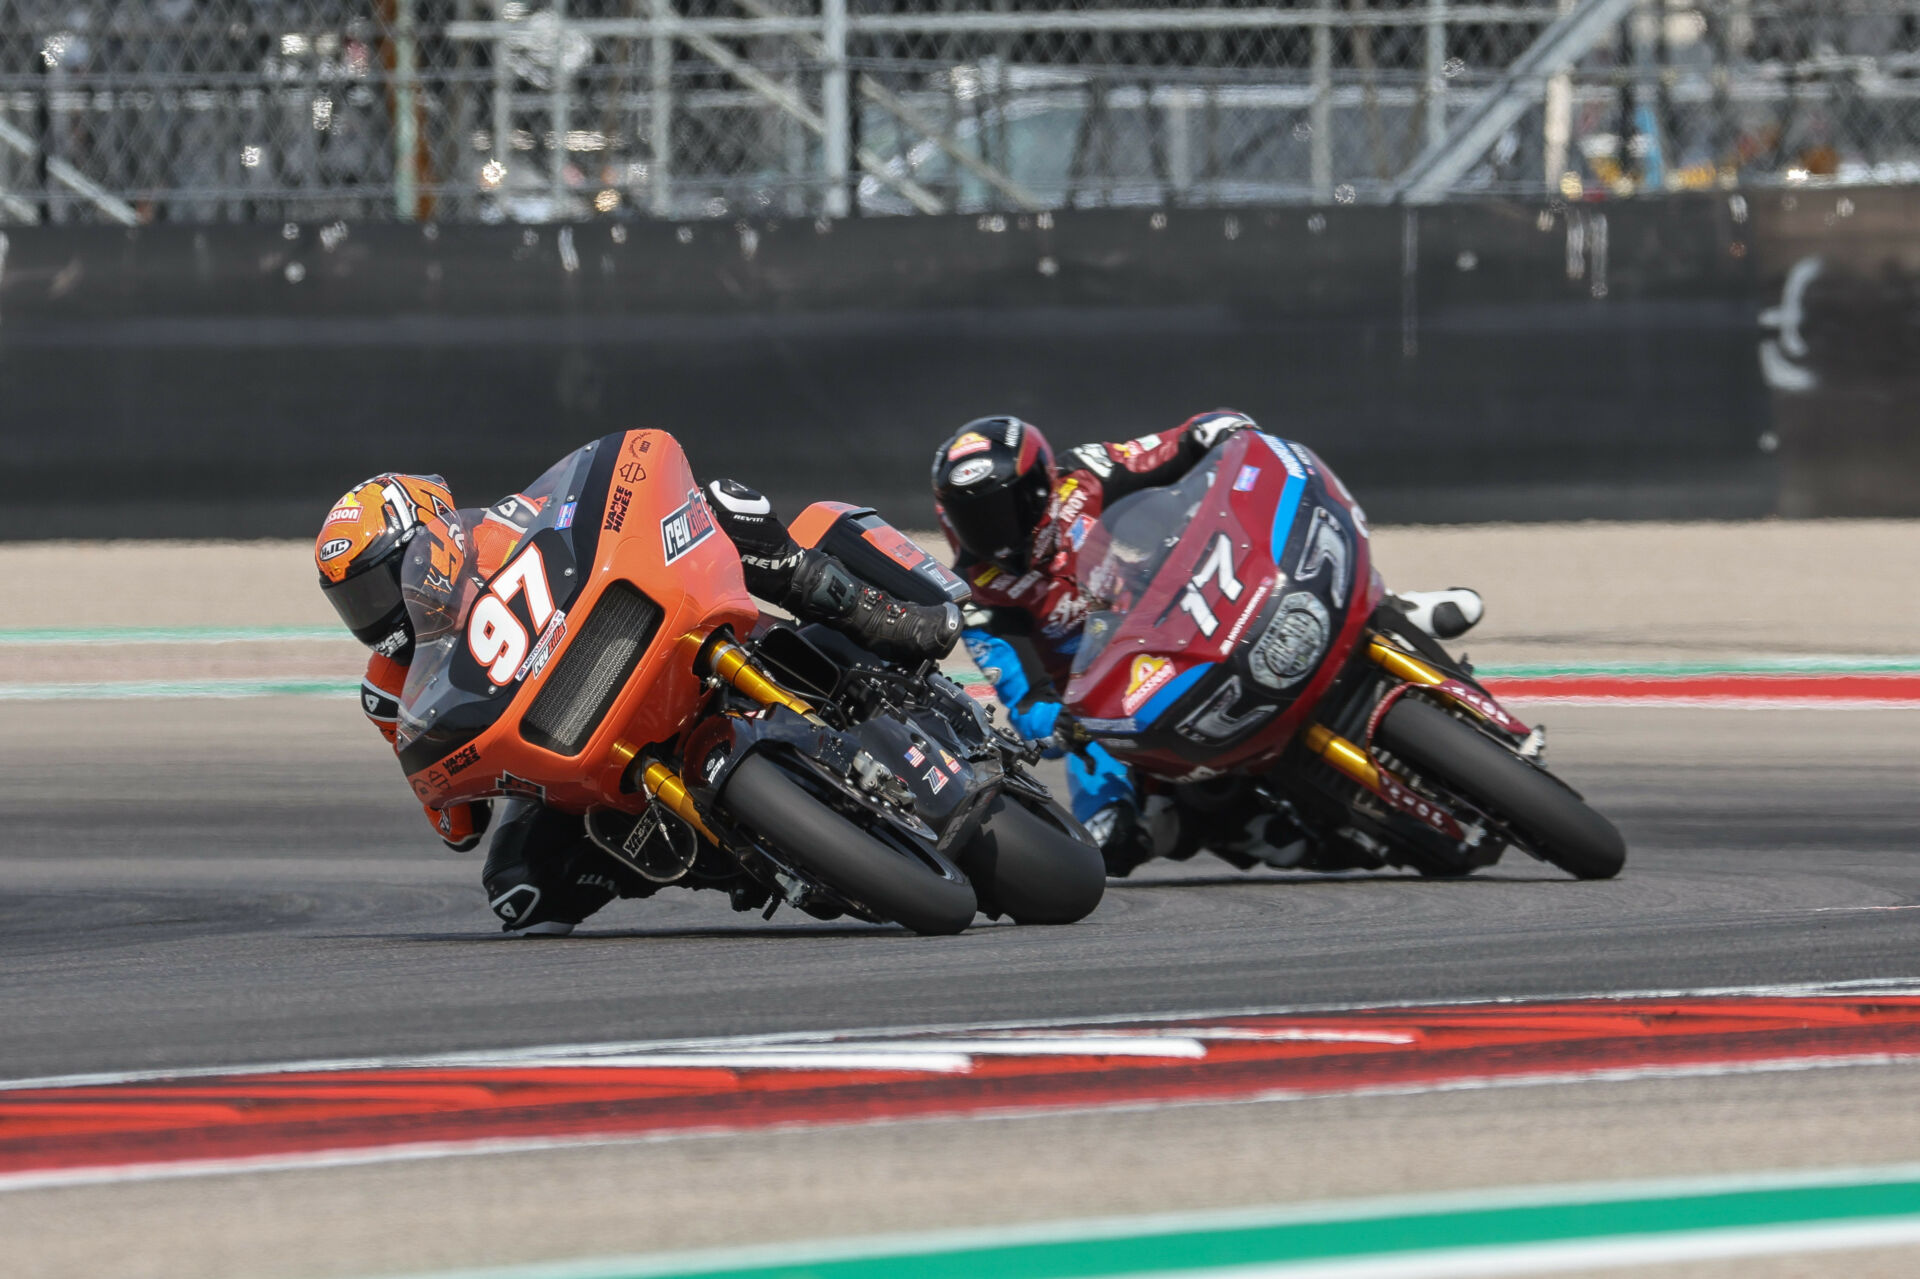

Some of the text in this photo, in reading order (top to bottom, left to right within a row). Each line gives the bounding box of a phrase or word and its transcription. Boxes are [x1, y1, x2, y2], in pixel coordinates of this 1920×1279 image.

[327, 508, 359, 521] sion
[604, 485, 625, 531] VANCE
[612, 489, 633, 533] HINES
[321, 541, 346, 558] HJC
[1179, 532, 1244, 638] 17
[468, 541, 556, 686] 97
[524, 620, 558, 668] MOTOAMERICA
[534, 623, 566, 675] revzilla
[442, 743, 477, 769] VANCE
